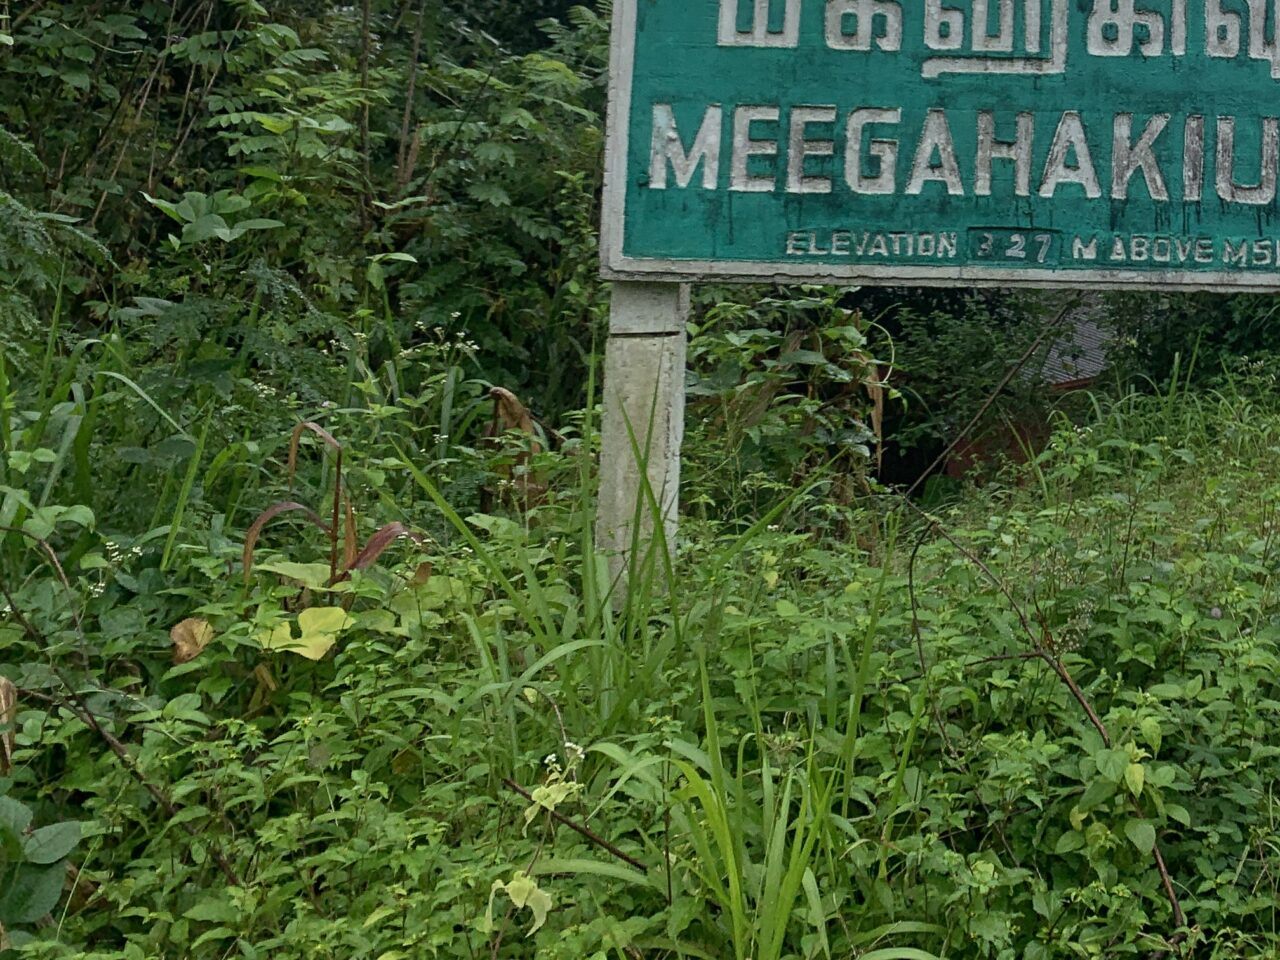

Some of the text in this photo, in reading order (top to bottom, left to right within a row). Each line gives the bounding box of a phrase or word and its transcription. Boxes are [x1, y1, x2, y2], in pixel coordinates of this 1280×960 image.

[785, 230, 958, 258] ELEVATION
[976, 232, 1052, 264] 327
[1108, 233, 1214, 262] ABOVE
